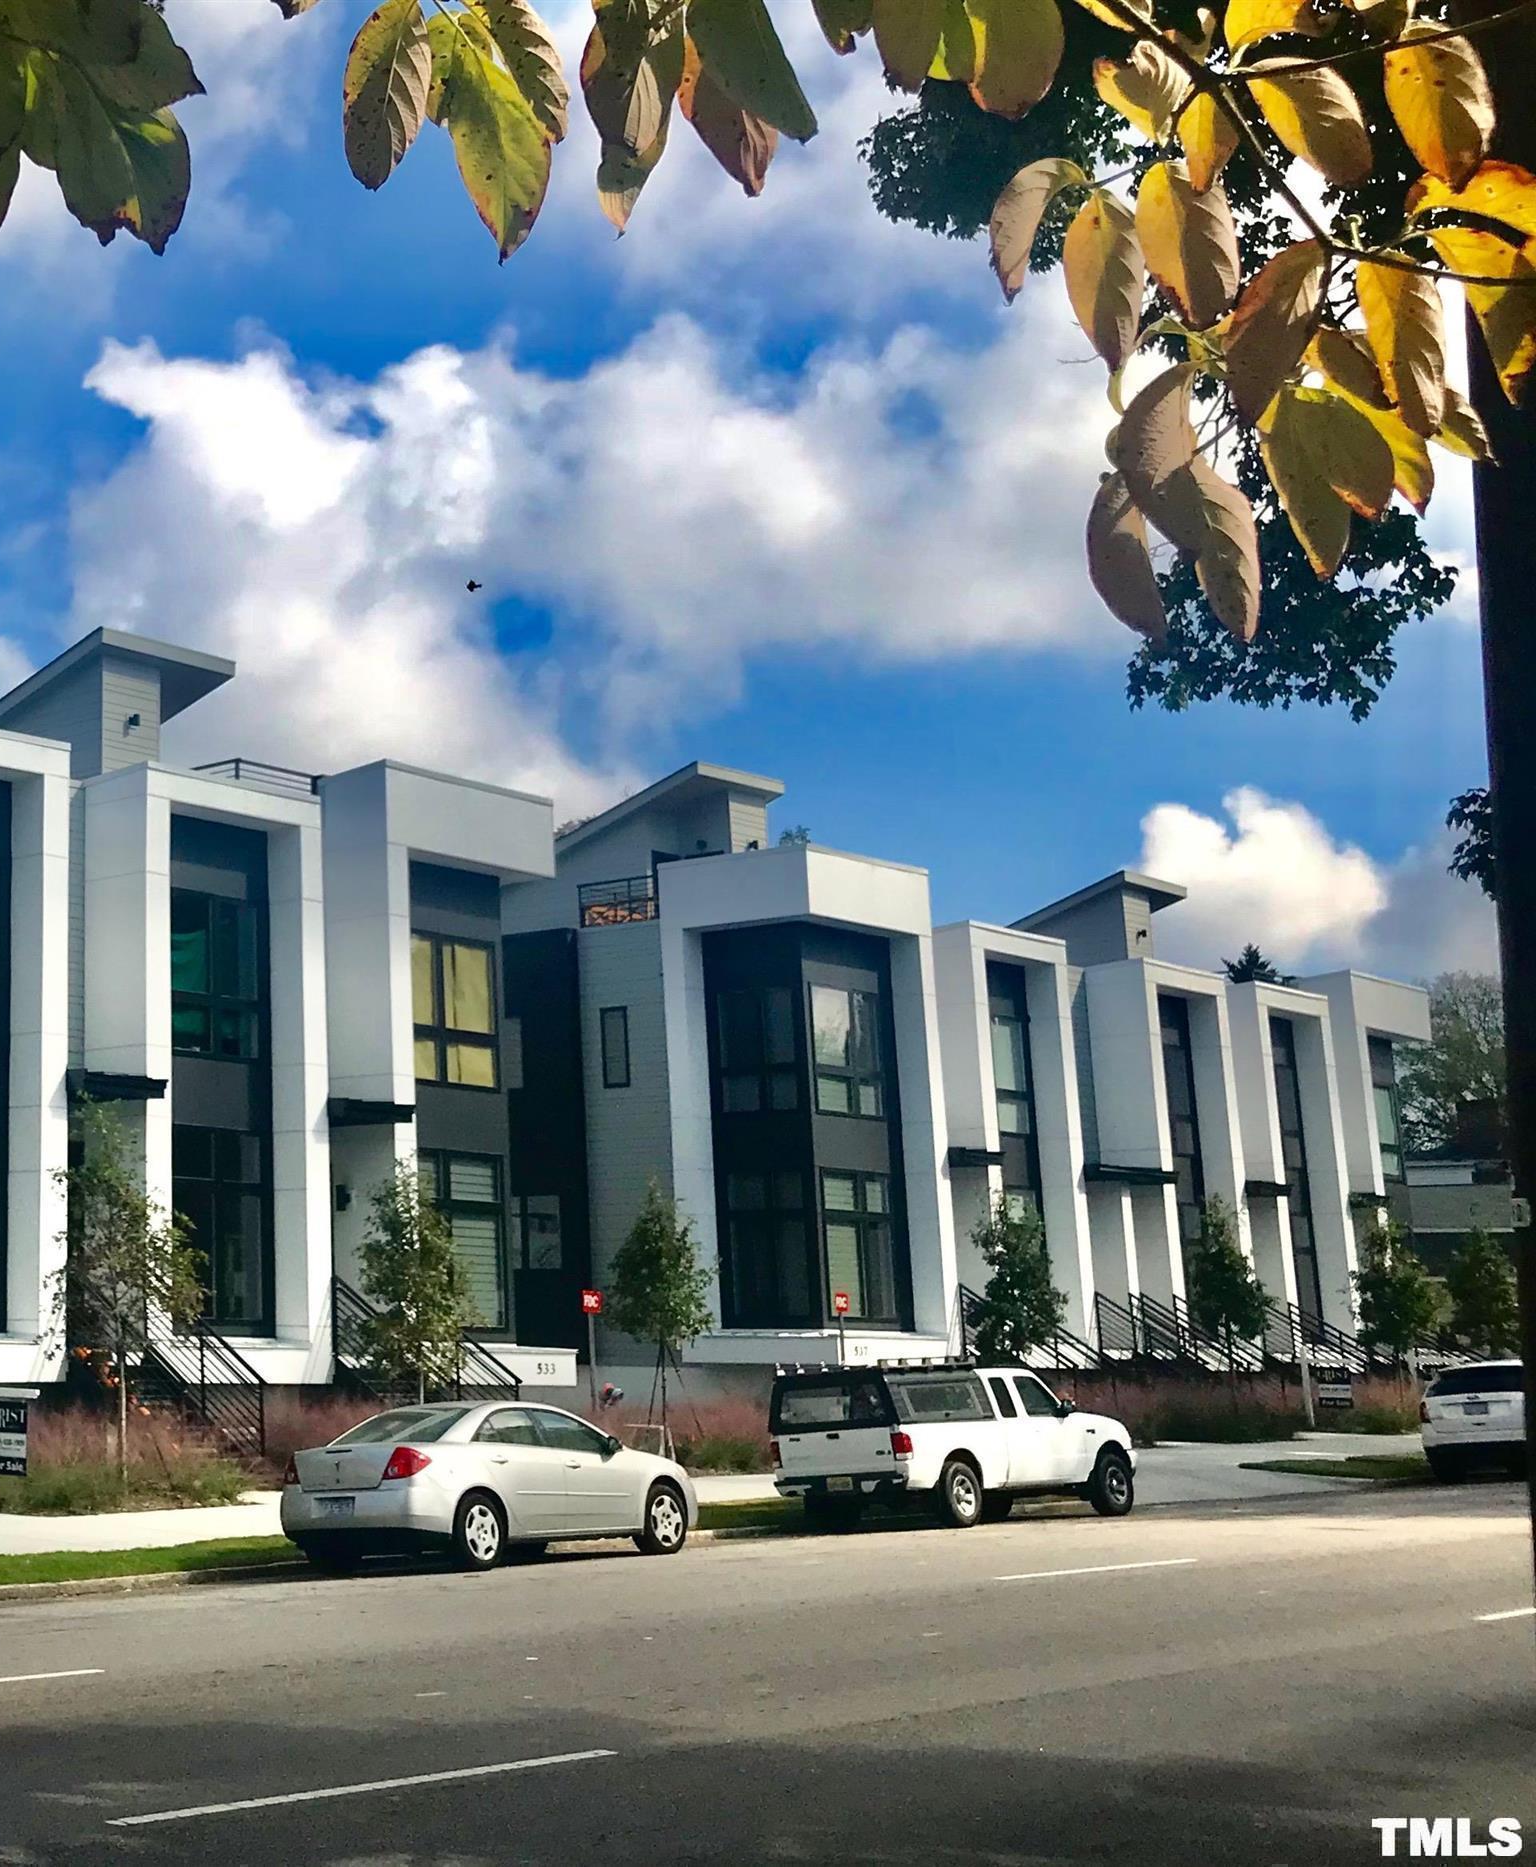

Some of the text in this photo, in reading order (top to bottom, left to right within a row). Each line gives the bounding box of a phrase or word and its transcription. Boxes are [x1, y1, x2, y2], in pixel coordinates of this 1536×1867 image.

[583, 1294, 600, 1308] FDC
[854, 1346, 869, 1357] 537
[536, 1362, 556, 1375] 533
[5, 1461, 24, 1472] Sale
